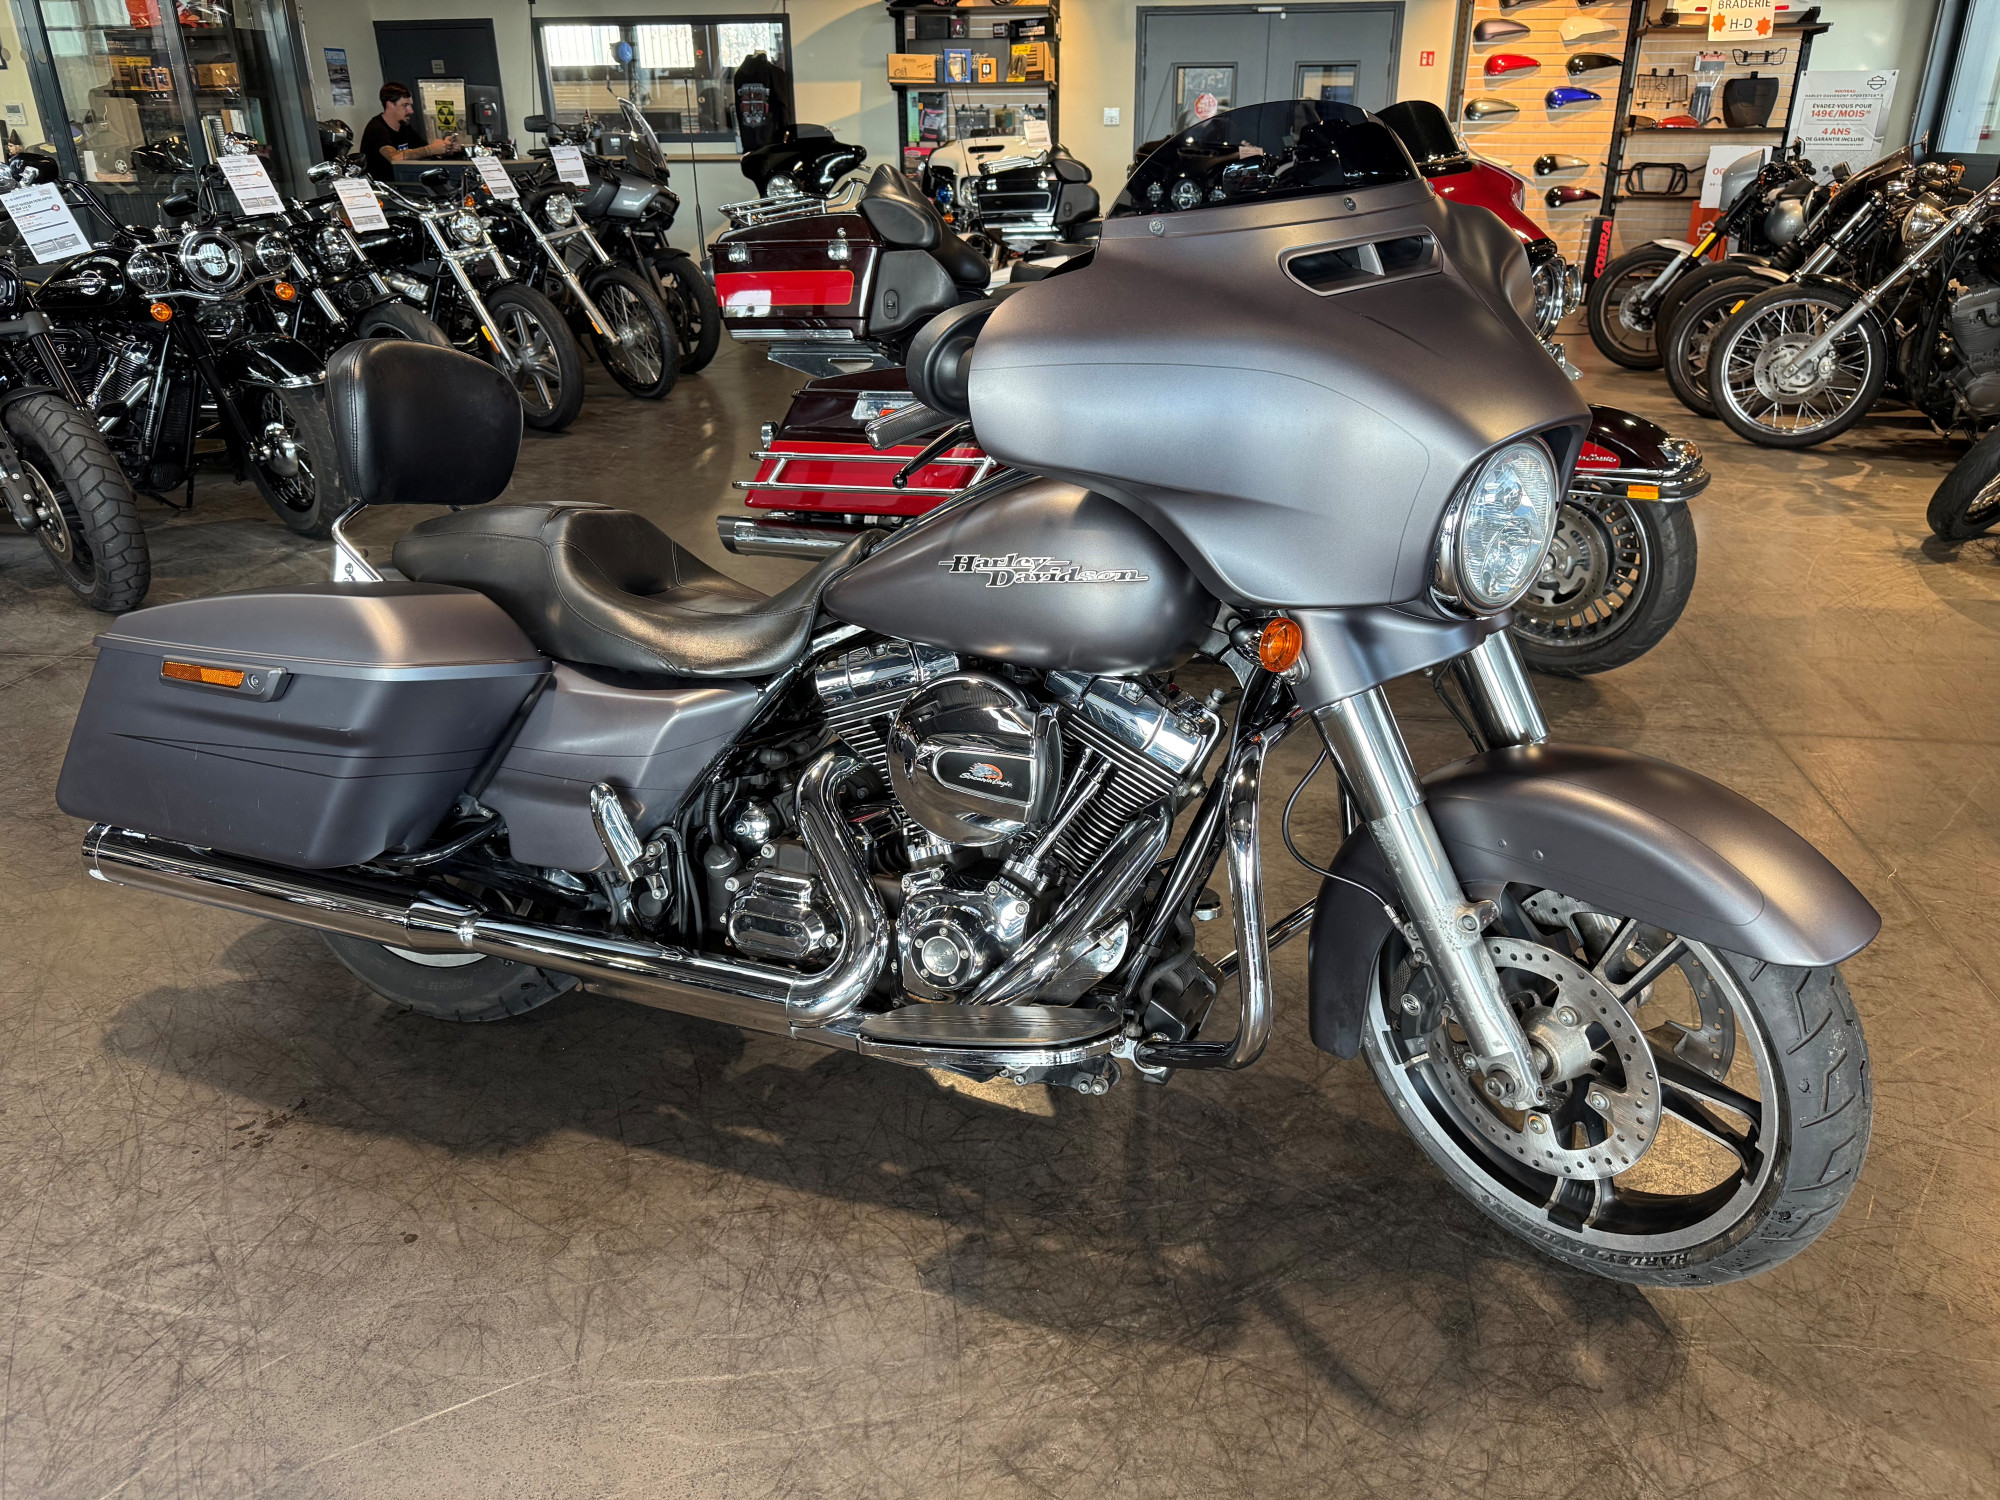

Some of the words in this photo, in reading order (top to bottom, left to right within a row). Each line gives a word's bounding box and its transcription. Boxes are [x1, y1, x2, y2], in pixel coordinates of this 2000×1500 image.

[1718, 0, 1771, 9] BRADERIE
[1730, 18, 1753, 29] H-D
[1594, 221, 1612, 278] COBRA
[944, 553, 1067, 575] Harley
[986, 565, 1149, 588] Davidson
